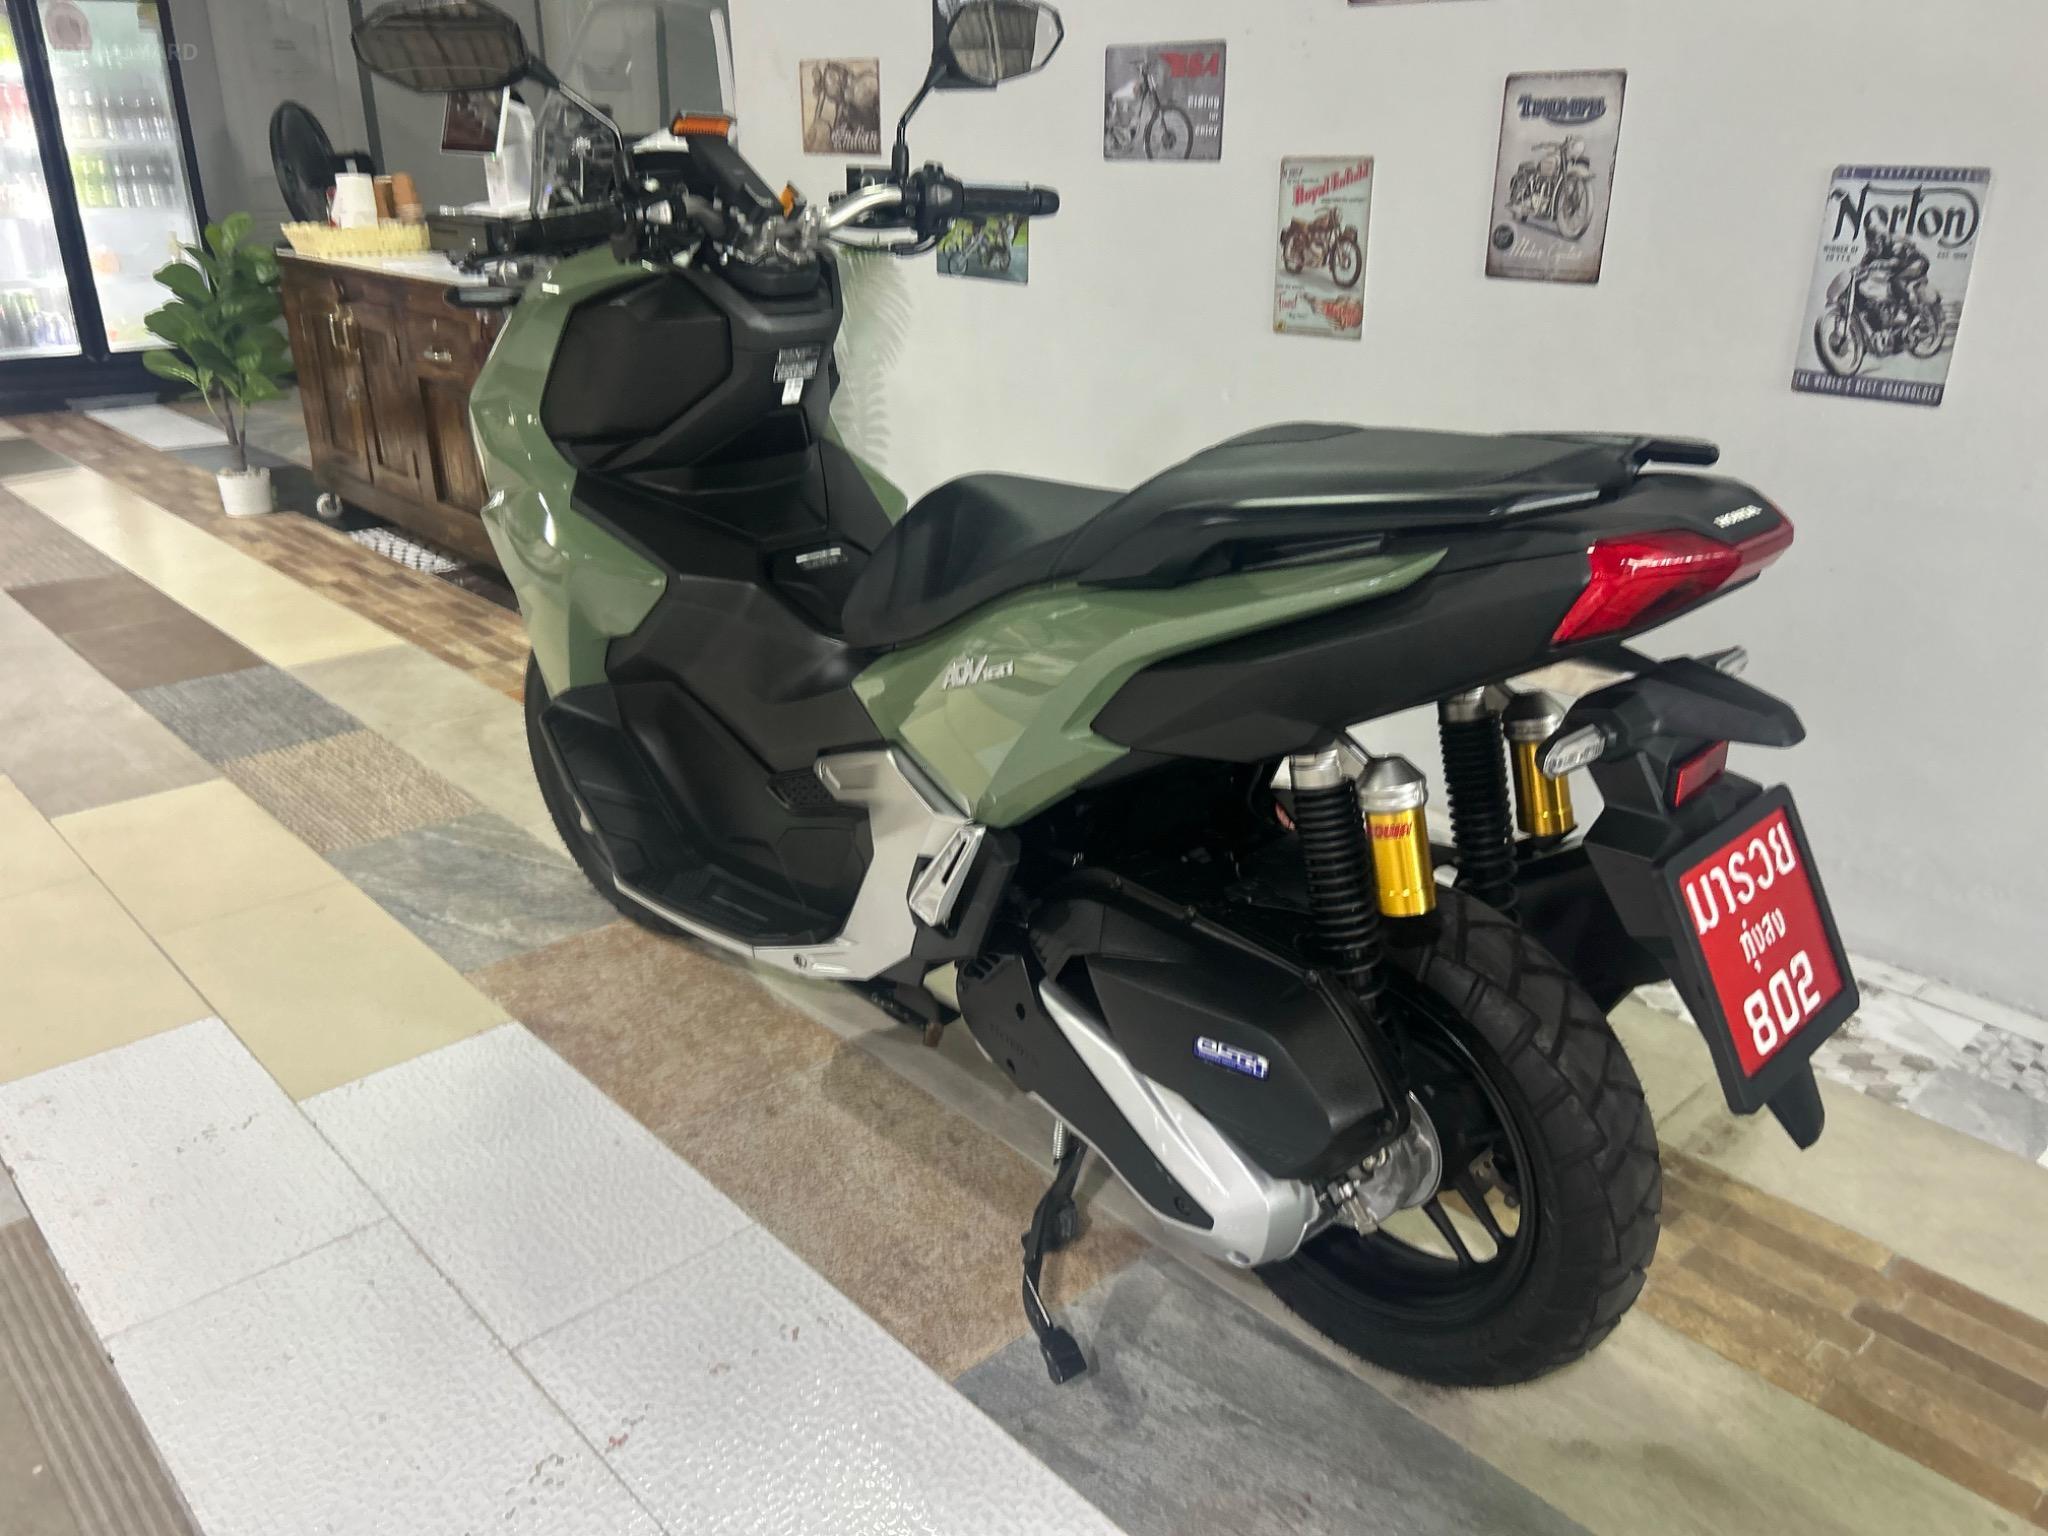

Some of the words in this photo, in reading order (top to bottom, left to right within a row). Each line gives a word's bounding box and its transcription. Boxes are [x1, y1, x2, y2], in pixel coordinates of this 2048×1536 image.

[1160, 51, 1220, 80] BSA
[1293, 176, 1330, 207] Royal
[1329, 157, 1369, 193] Enfield
[1831, 181, 1980, 249] Norton
[1813, 374, 1852, 392] WORLD'S
[1854, 379, 1878, 396] BEST
[1880, 382, 1941, 400] ROADHOLDER
[1686, 820, 1797, 935] มารวย
[1743, 949, 1822, 1057] 802
